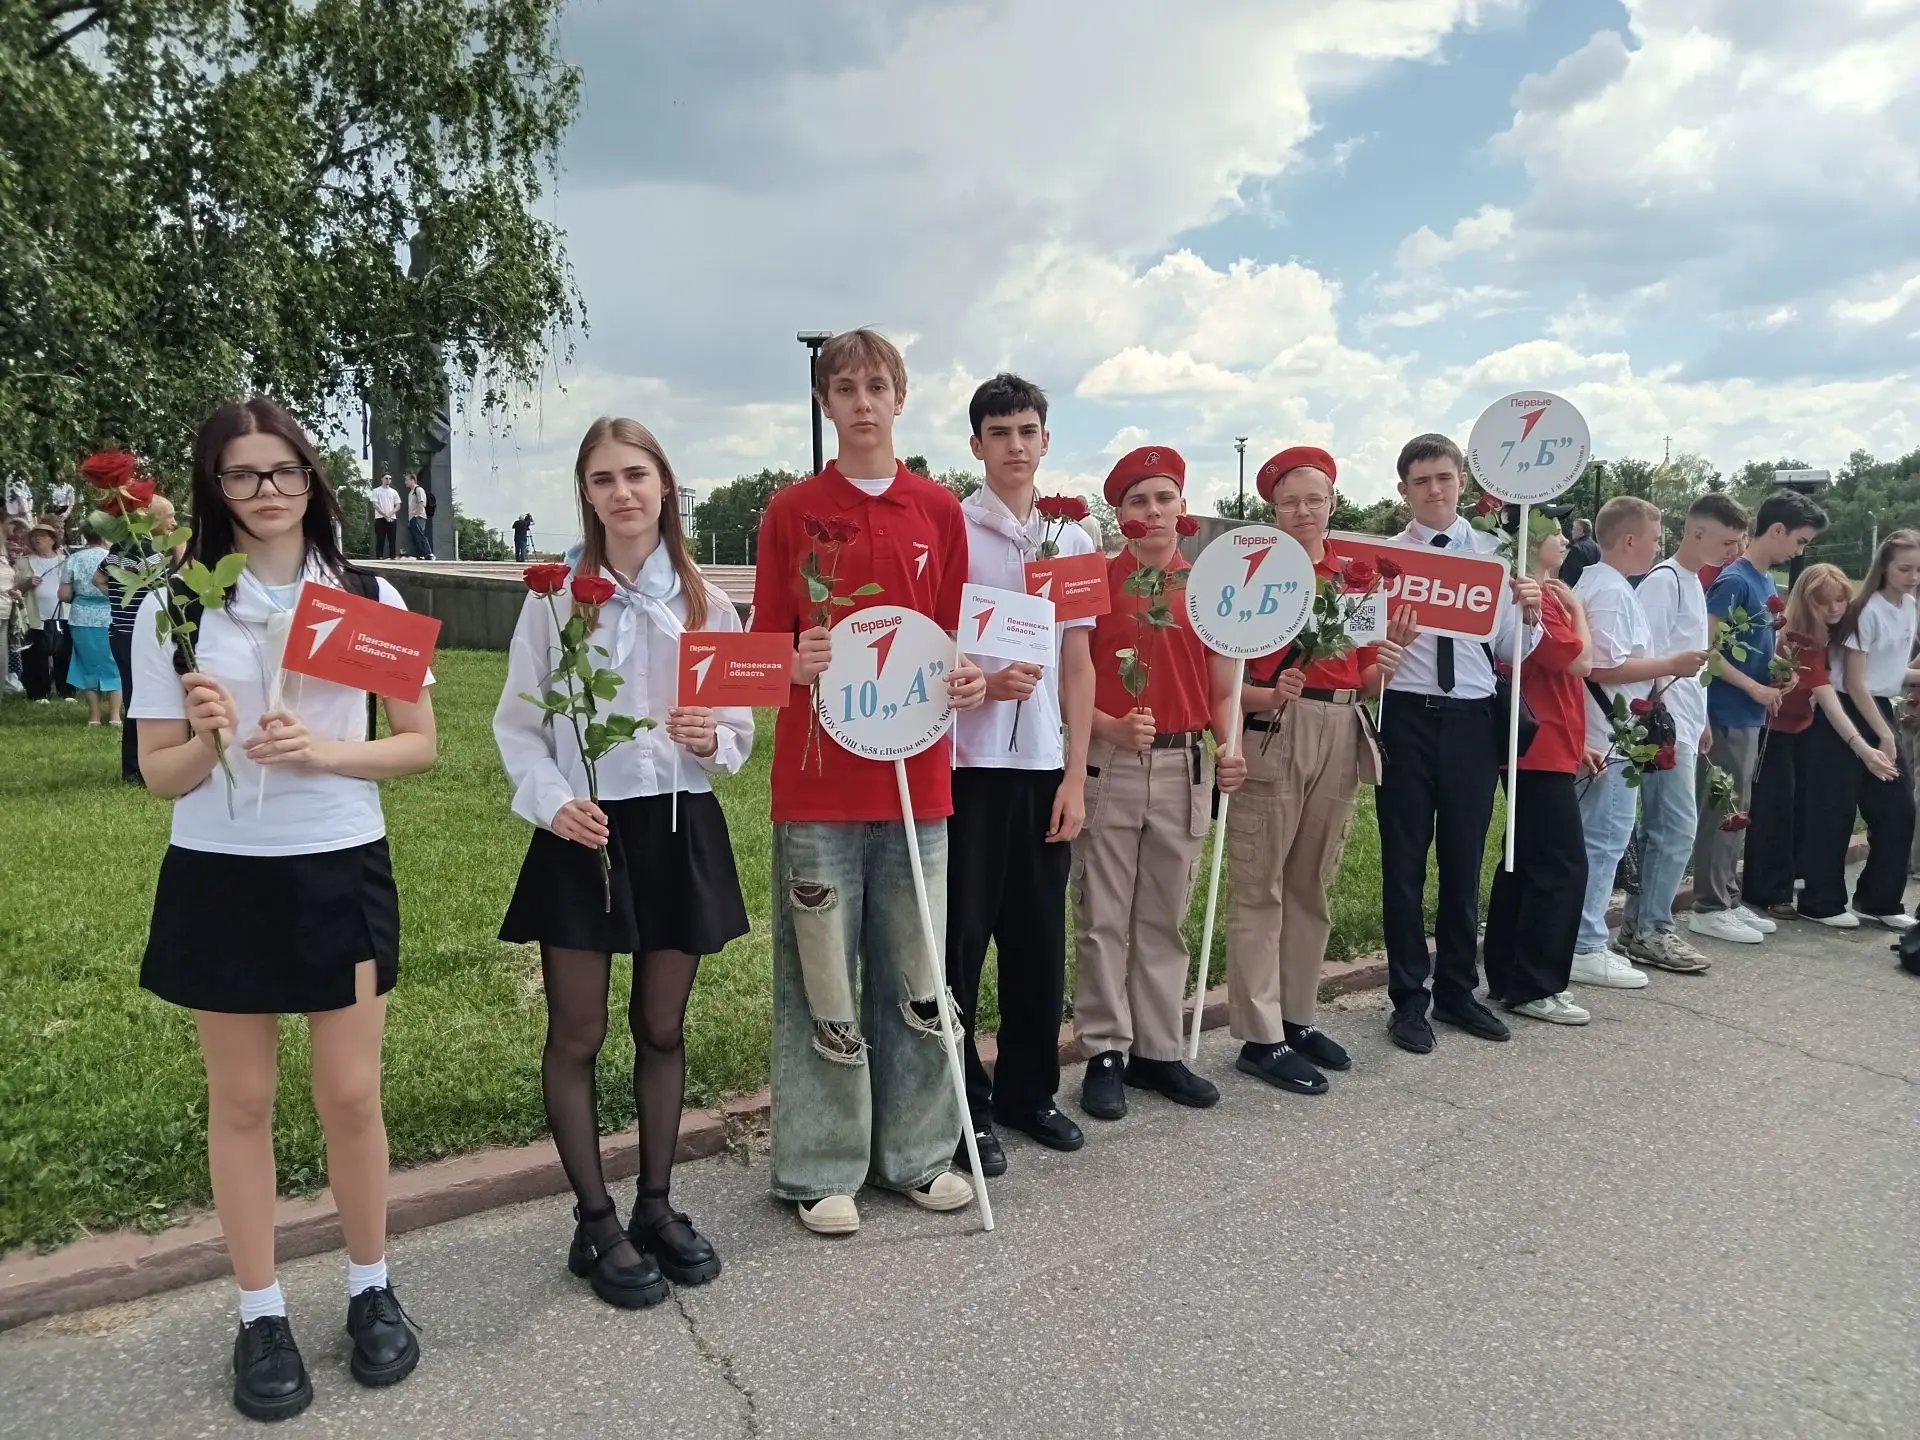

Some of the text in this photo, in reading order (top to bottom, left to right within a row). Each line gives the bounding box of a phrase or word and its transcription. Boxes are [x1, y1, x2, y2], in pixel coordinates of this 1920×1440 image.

[1510, 398, 1552, 409] Первые
[1233, 535, 1278, 548] Первые
[1064, 577, 1102, 588] Пензенская
[1065, 586, 1091, 595] область
[972, 595, 996, 605] Первые
[311, 598, 346, 615] Первые
[850, 615, 902, 634] Первые
[1006, 625, 1036, 636] область
[1007, 617, 1049, 632] Пензенская
[1197, 624, 1214, 642] СОШ
[357, 632, 420, 657] Пензенская
[689, 645, 717, 653] Первые
[354, 643, 397, 661] область
[729, 661, 782, 669] Пензенская
[729, 669, 765, 677] область
[818, 699, 837, 730] МБОУ
[835, 729, 858, 749] СОШ
[857, 744, 878, 755] №58
[915, 737, 929, 748] им.
[927, 724, 943, 737] Г.В.
